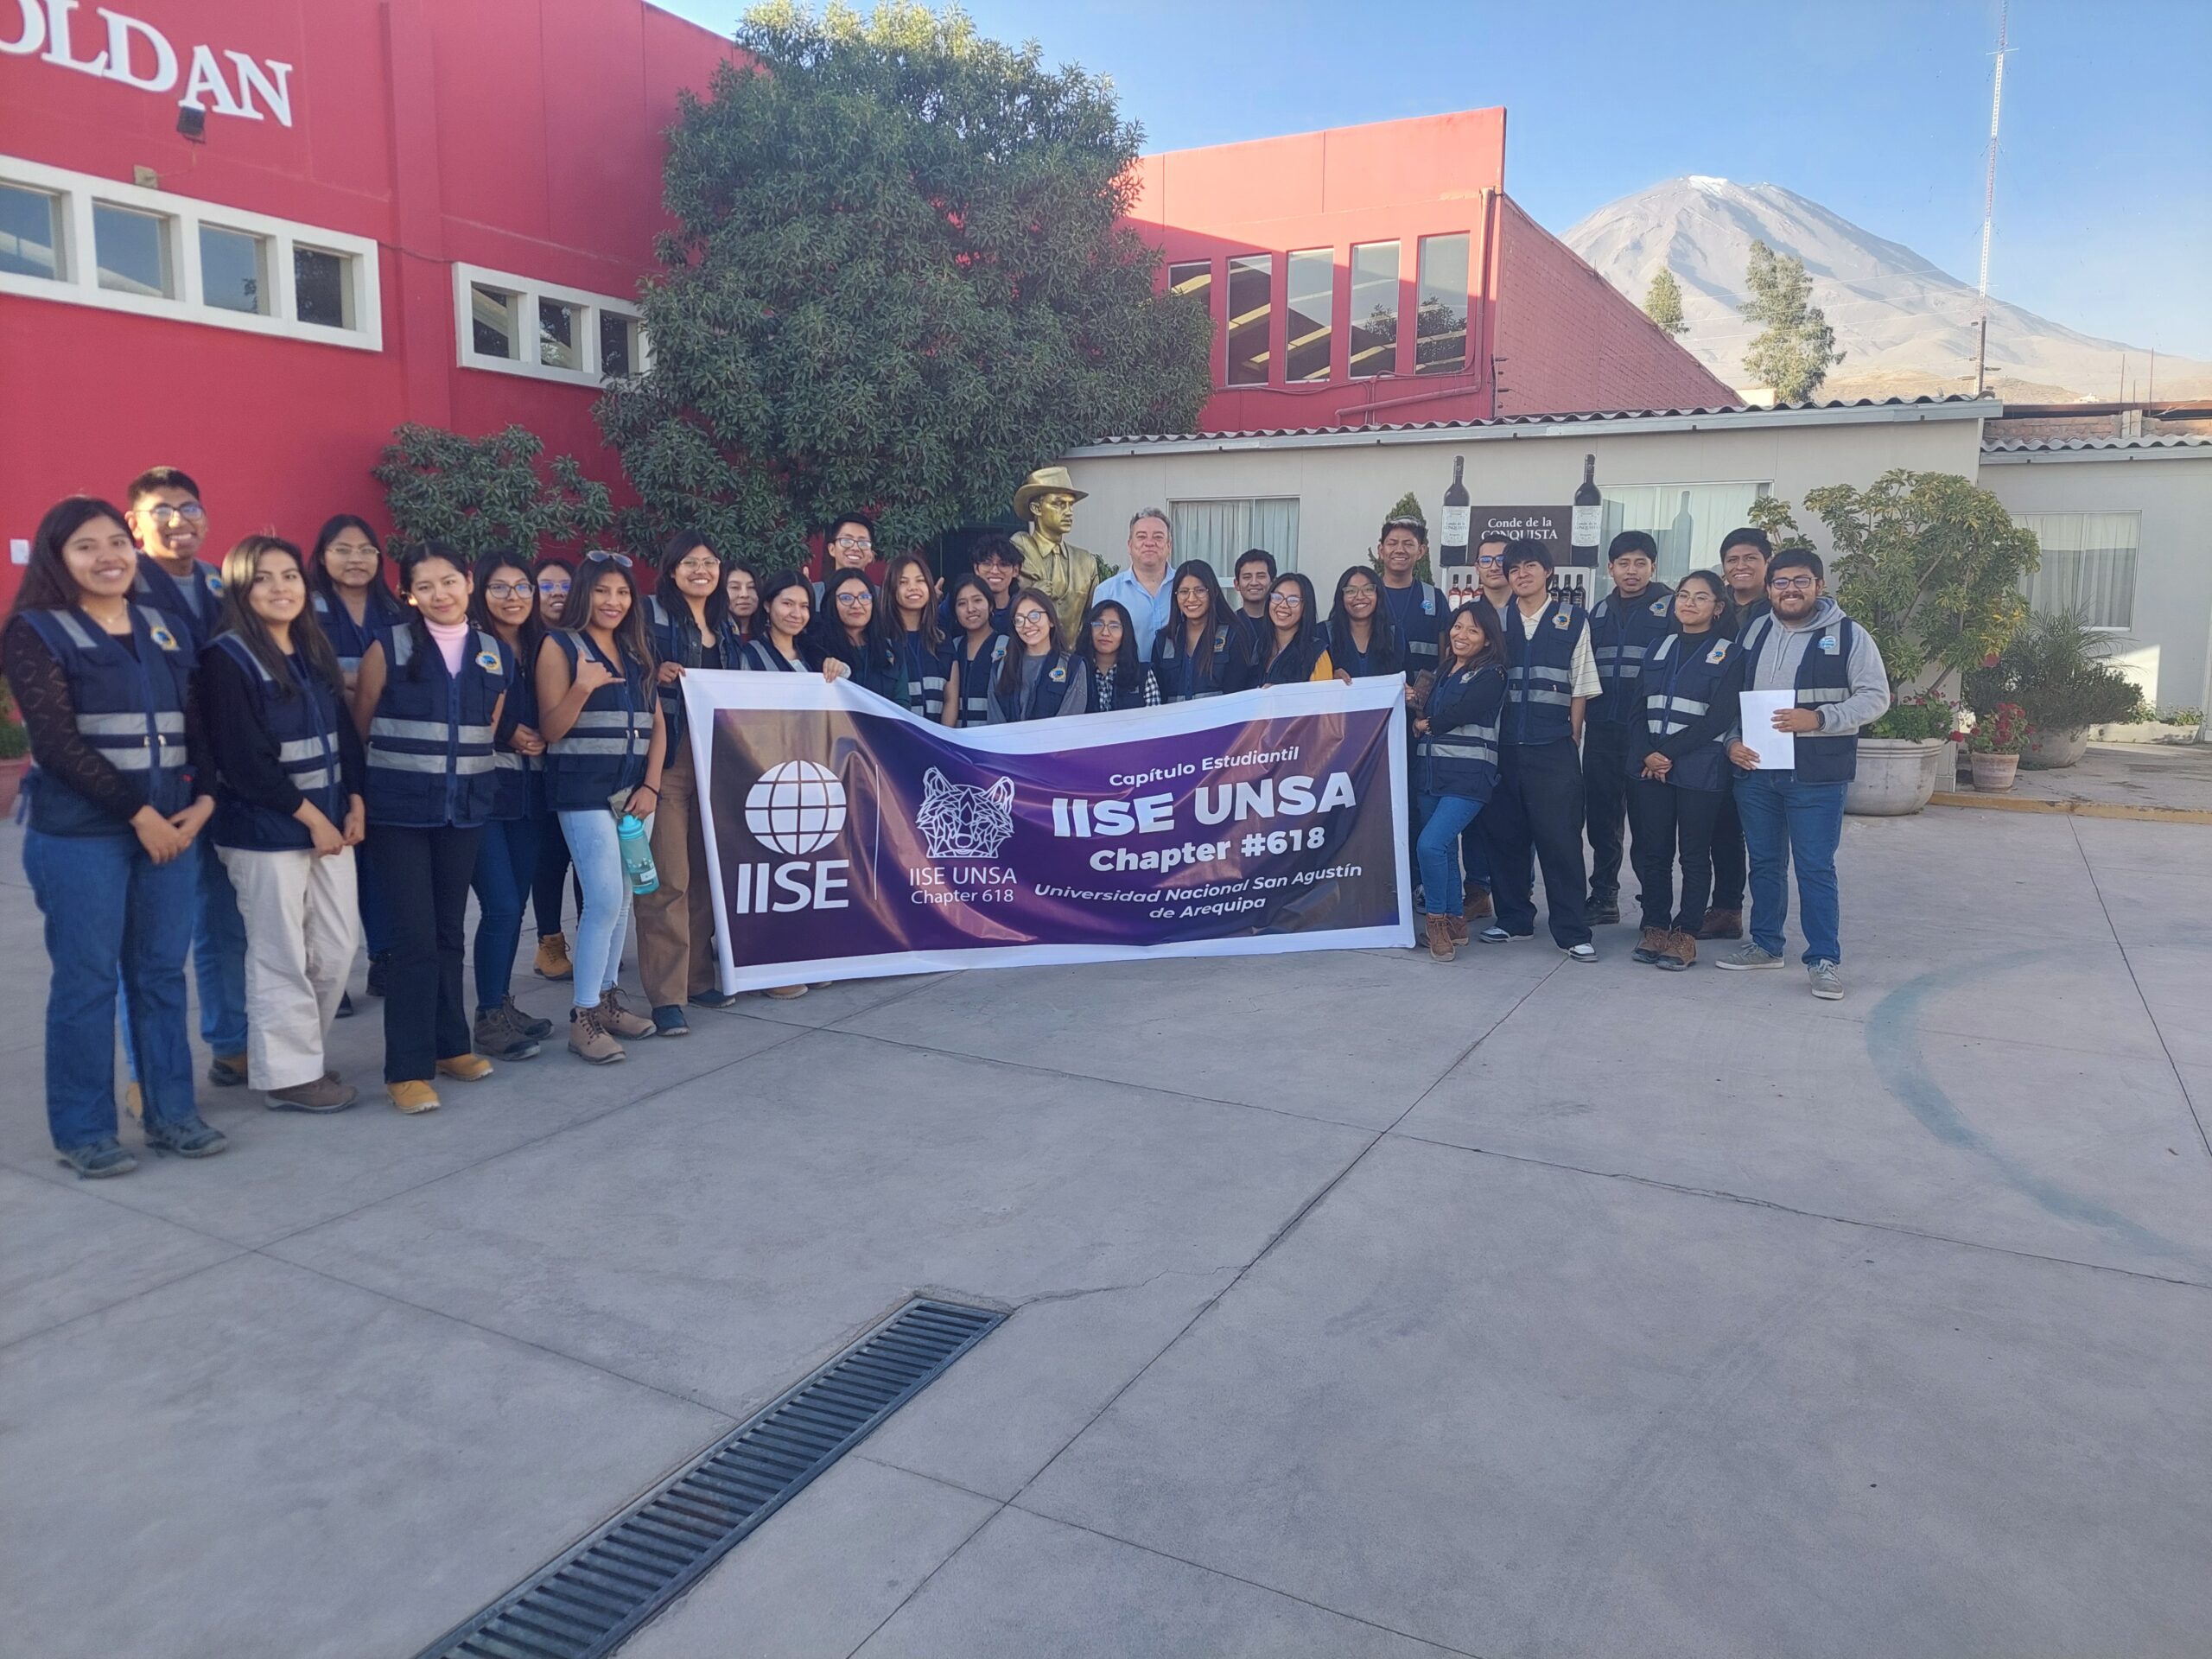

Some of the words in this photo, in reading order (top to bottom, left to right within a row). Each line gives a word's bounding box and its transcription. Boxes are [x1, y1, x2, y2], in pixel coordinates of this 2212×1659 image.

[1488, 518, 1522, 528] Conde
[1526, 517, 1539, 527] de
[1542, 517, 1552, 526] la
[1109, 764, 1195, 788] Capítulo
[1202, 747, 1299, 771] Estudiantil
[1052, 792, 1174, 838] IISE
[1195, 772, 1357, 825] UNSA
[1090, 840, 1231, 873] Chapter
[1241, 827, 1325, 857] #618
[736, 860, 849, 913] IISE
[910, 867, 945, 886] IISE
[952, 867, 1017, 885] UNSA
[1034, 884, 1160, 903] Universidad
[1165, 879, 1249, 901] Nacional
[1252, 876, 1287, 890] San
[1291, 863, 1362, 887] Agustín
[911, 890, 976, 906] Chapter
[982, 889, 1014, 902] 618
[1149, 907, 1174, 919] de
[1179, 896, 1266, 918] Arequipa
